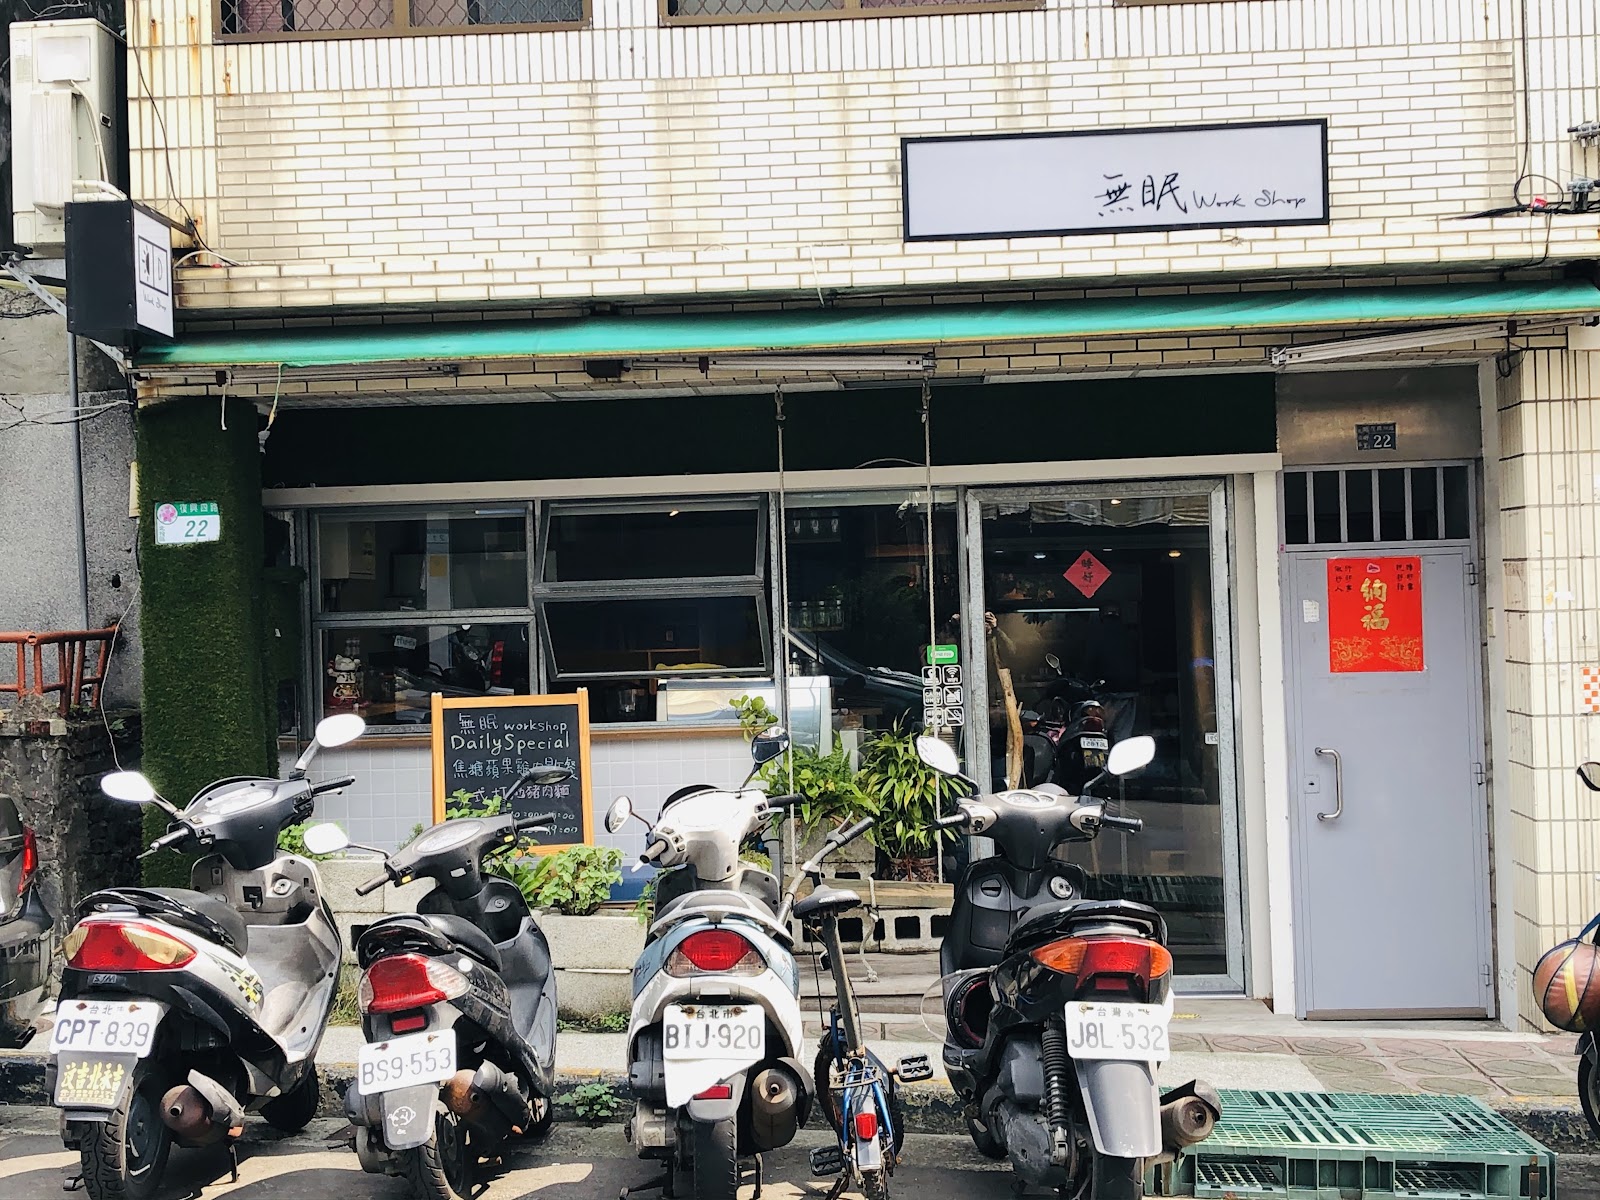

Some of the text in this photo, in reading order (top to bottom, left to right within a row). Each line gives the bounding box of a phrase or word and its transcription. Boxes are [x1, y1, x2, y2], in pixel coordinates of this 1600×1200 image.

[1095, 173, 1307, 216] 無眠 Work Shop
[1373, 434, 1392, 448] 22
[184, 520, 208, 537] 22
[1360, 577, 1389, 631] 納福
[504, 719, 567, 734] workshop
[696, 1008, 733, 1019] 台北市
